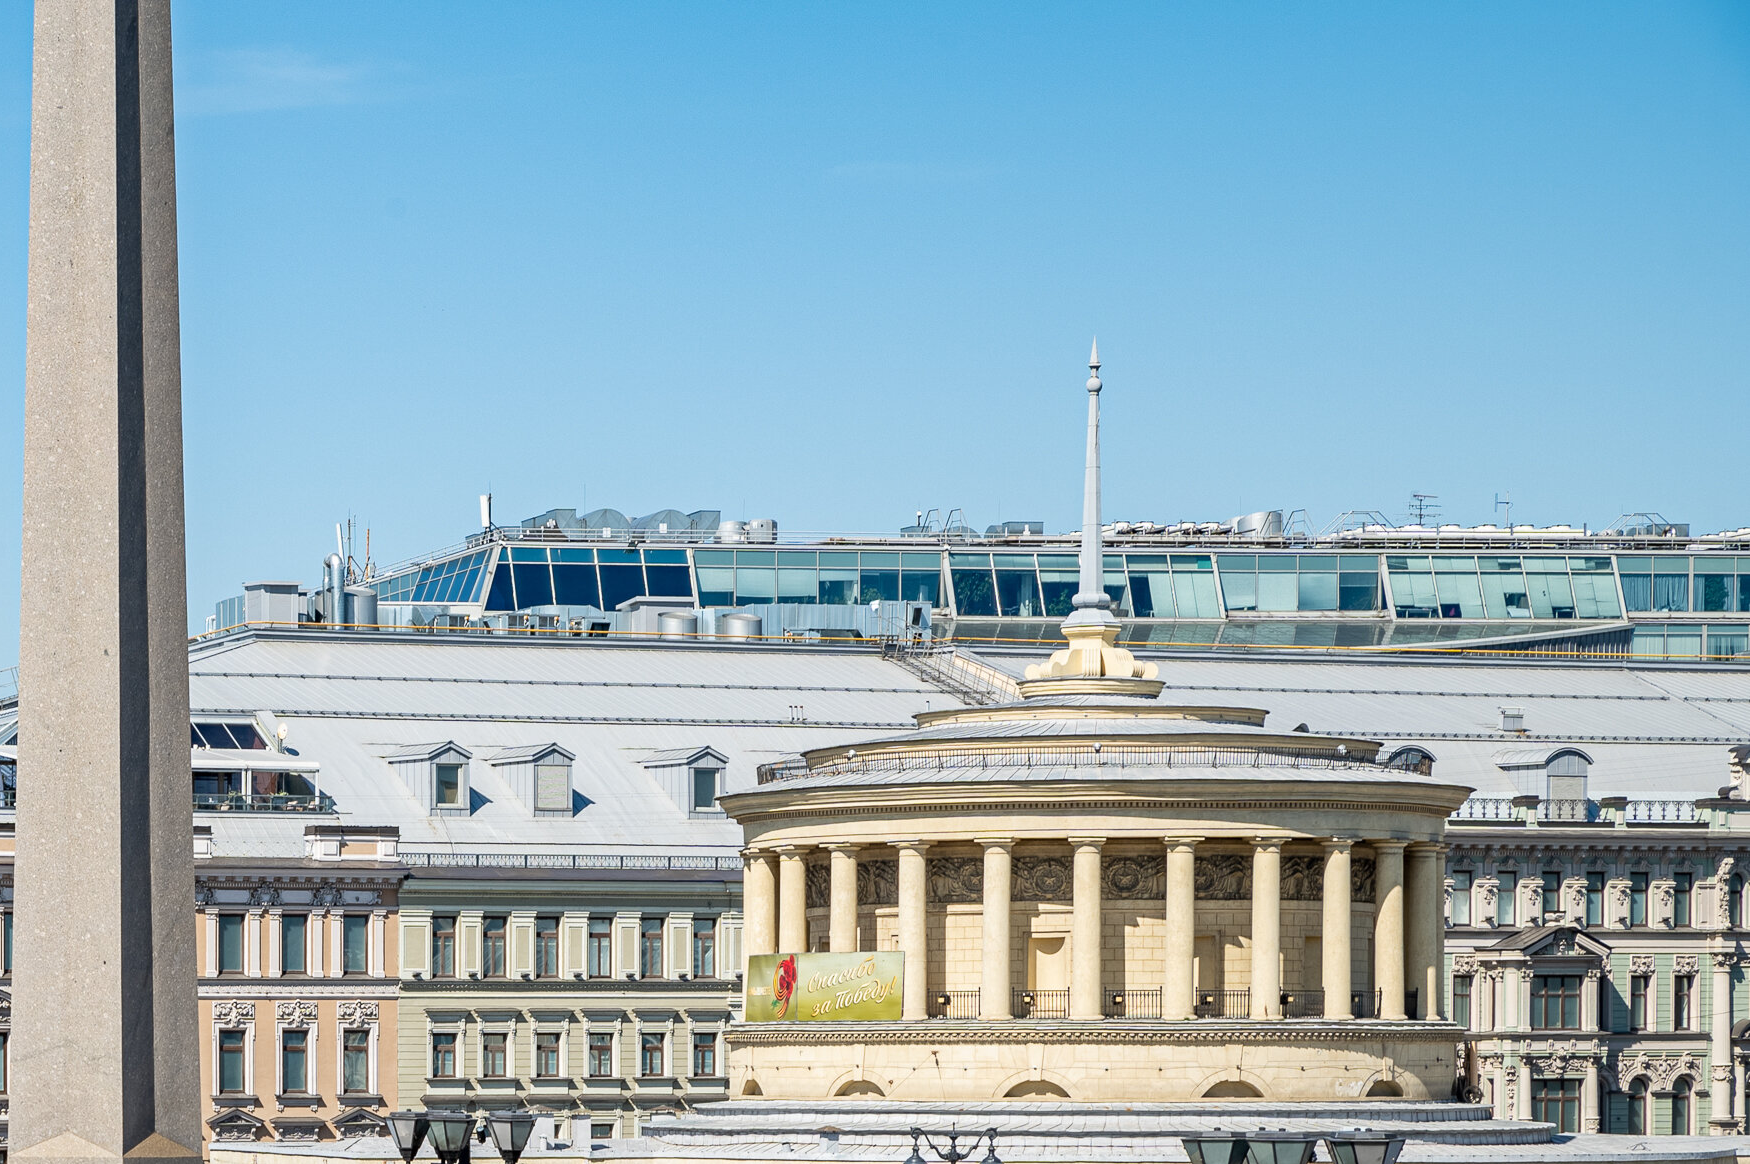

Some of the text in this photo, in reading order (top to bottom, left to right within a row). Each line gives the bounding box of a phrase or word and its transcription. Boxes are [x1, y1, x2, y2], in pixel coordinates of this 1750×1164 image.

[808, 955, 877, 993] Спасибо
[811, 976, 898, 1017] за Победу!
